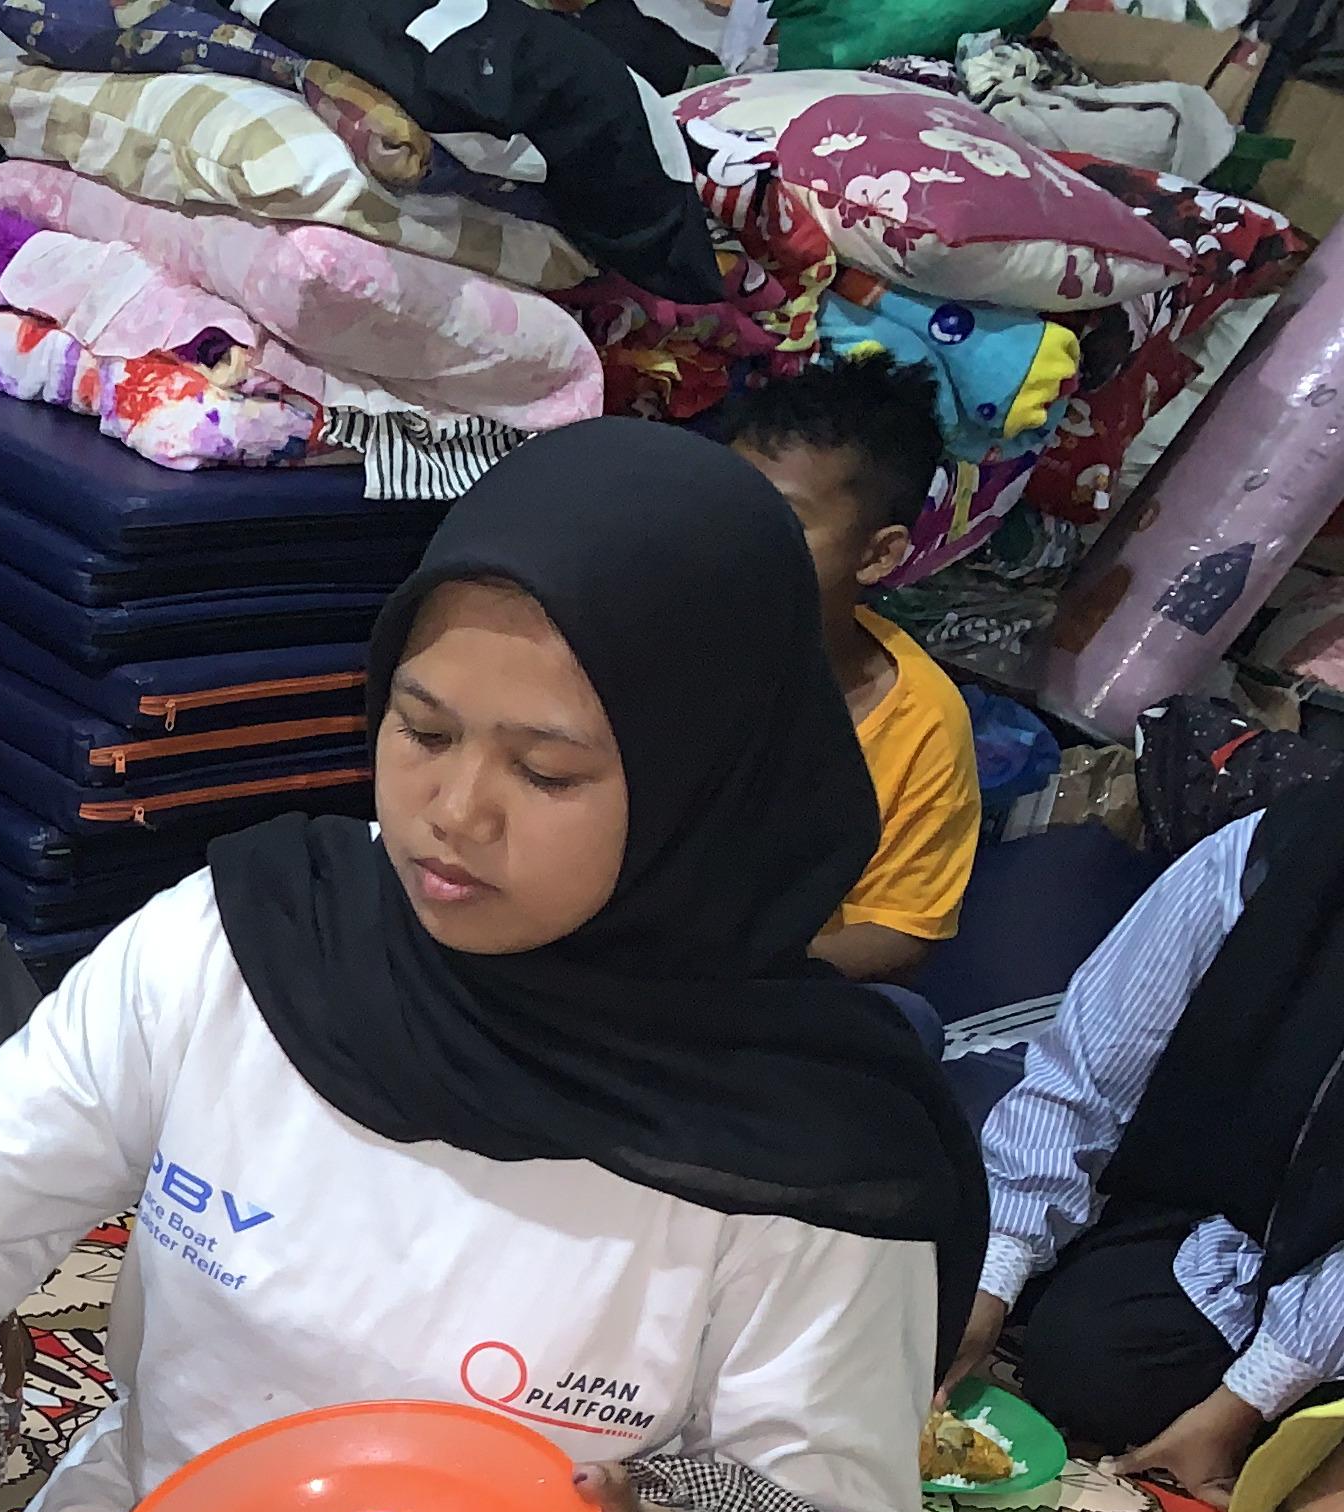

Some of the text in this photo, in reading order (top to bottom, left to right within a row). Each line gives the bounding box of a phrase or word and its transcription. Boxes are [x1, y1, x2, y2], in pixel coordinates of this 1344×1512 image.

[168, 1211, 218, 1252] Boat
[181, 1245, 248, 1290] Relief
[556, 1371, 641, 1402] JAPAN
[524, 1387, 656, 1430] PLATFORM
